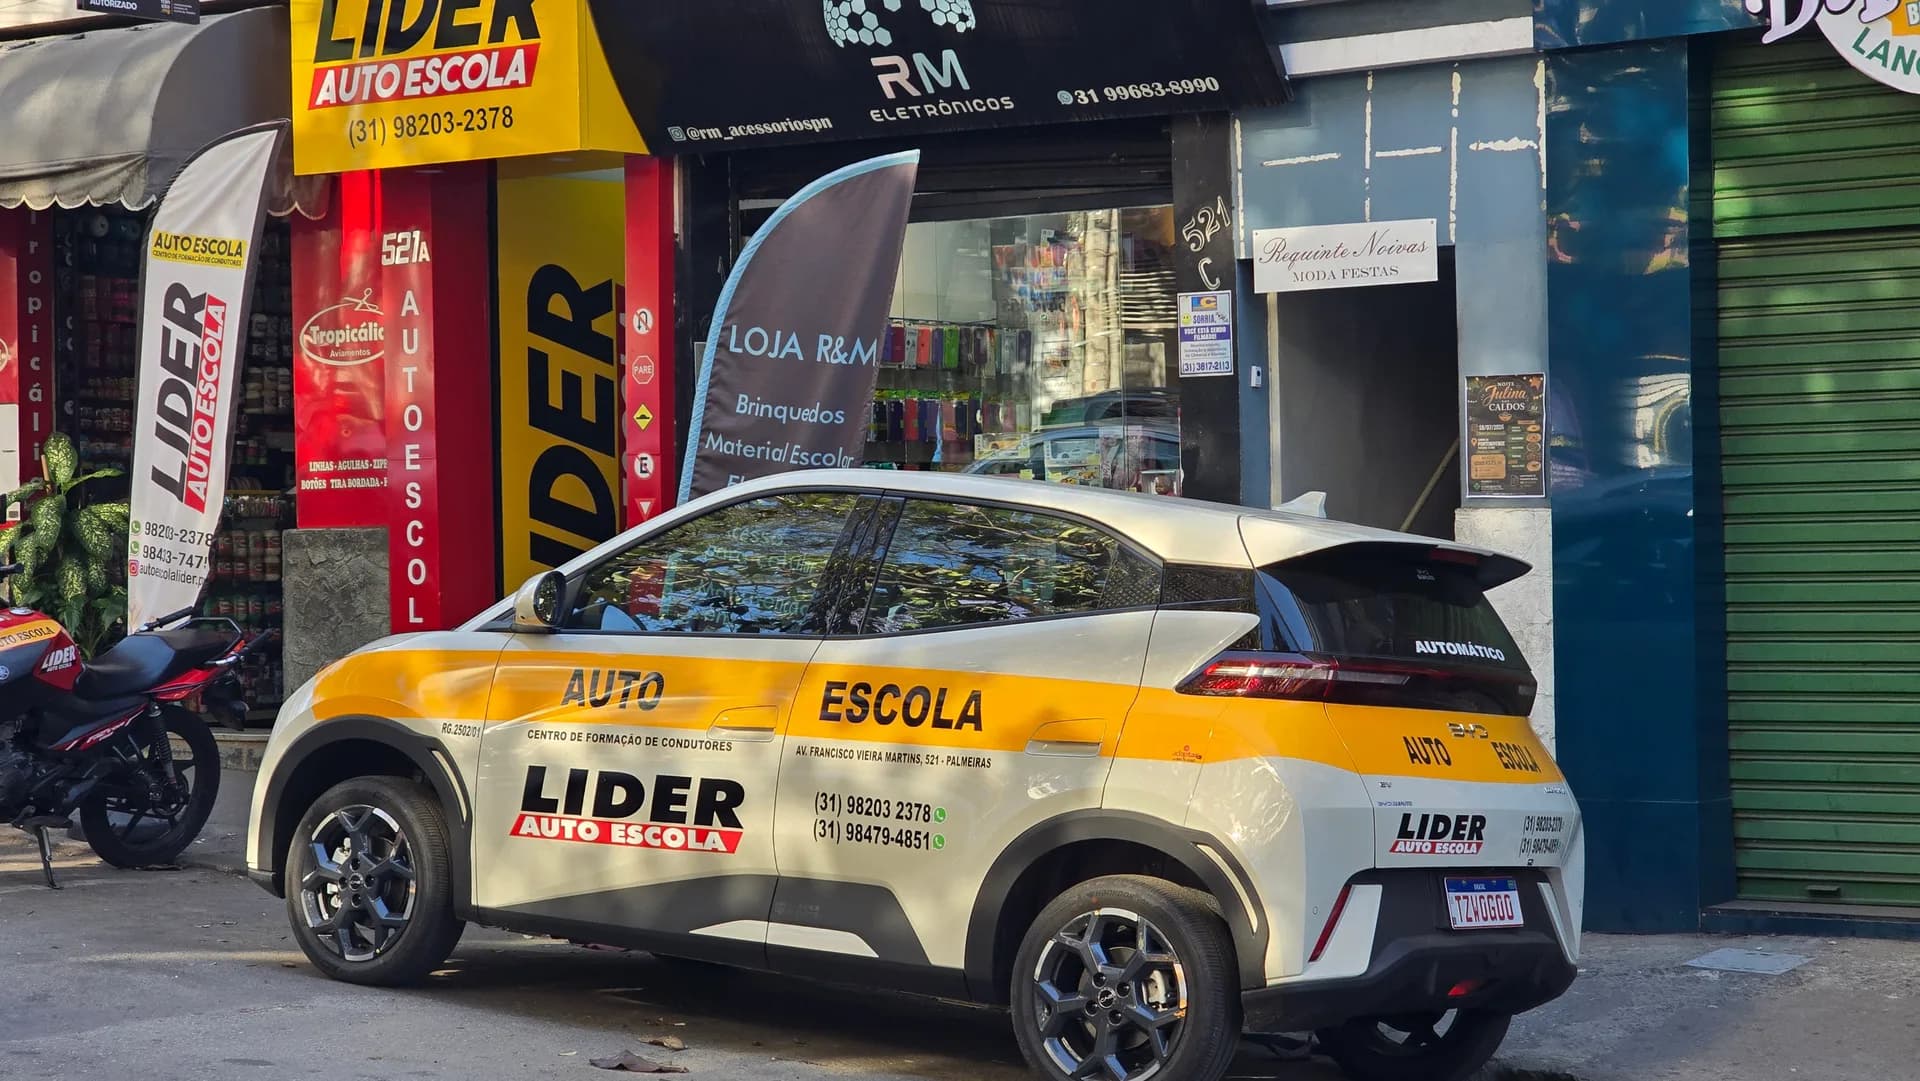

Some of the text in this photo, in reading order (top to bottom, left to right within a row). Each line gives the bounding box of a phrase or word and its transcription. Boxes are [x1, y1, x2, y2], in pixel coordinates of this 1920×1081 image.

[313, 0, 541, 63] LIDER
[315, 49, 527, 106] AUTO ESCOLA
[870, 49, 971, 99] RM
[1074, 76, 1220, 105] 31 99683-8990
[869, 96, 1015, 122] ELETRÔNICOS
[348, 105, 514, 149] (31) 98203-2378
[686, 115, 833, 141] @rm_acessoriospn
[1181, 195, 1231, 252] 521
[152, 249, 171, 259] CENTRO
[154, 233, 243, 257] AUTO ESCOLA
[381, 230, 431, 265] 521A
[1259, 229, 1429, 271] Requinte Noivas
[1198, 257, 1221, 290] C
[1293, 265, 1399, 282] MODA FESTAS
[330, 348, 371, 358] Aviamentos
[729, 325, 878, 367] LOJA R&M
[634, 366, 653, 375] PARE
[151, 282, 208, 503] LIDER
[187, 304, 226, 502] AUTO ESCOLA
[1488, 402, 1526, 411] CALDOS
[527, 264, 617, 570] IDER
[735, 393, 845, 425] Brinquedos
[309, 460, 334, 472] LINHAS
[337, 459, 370, 471] AGULHAS
[705, 431, 855, 469] Material Escolar
[16, 626, 55, 641] ESCOLA
[41, 644, 77, 670] LIDER
[1415, 640, 1506, 662] AUTOMÁTICO
[560, 668, 665, 711] AUTO
[819, 680, 984, 732] ESCOLA
[441, 722, 481, 739] RG.2502/01
[527, 729, 733, 752] CENTRO DE FORMAÇÃO DE CONDUTORES
[795, 745, 808, 756] AV.
[809, 746, 854, 760] FRANCISCO
[856, 749, 883, 762] VIEIRA
[884, 751, 923, 767] MARTINS,
[925, 753, 939, 765] 521
[946, 755, 992, 769] PALMEIRAS
[1402, 735, 1542, 774] AUTO ESCOLA
[521, 765, 745, 829] LIDER
[814, 791, 931, 823] (31) 98203 2378
[519, 817, 728, 852] AUTO ESCOLA
[813, 818, 930, 851] (31) 98479-4851
[1396, 812, 1487, 841] LIDER
[1395, 840, 1478, 854] AUTO ESCOLA
